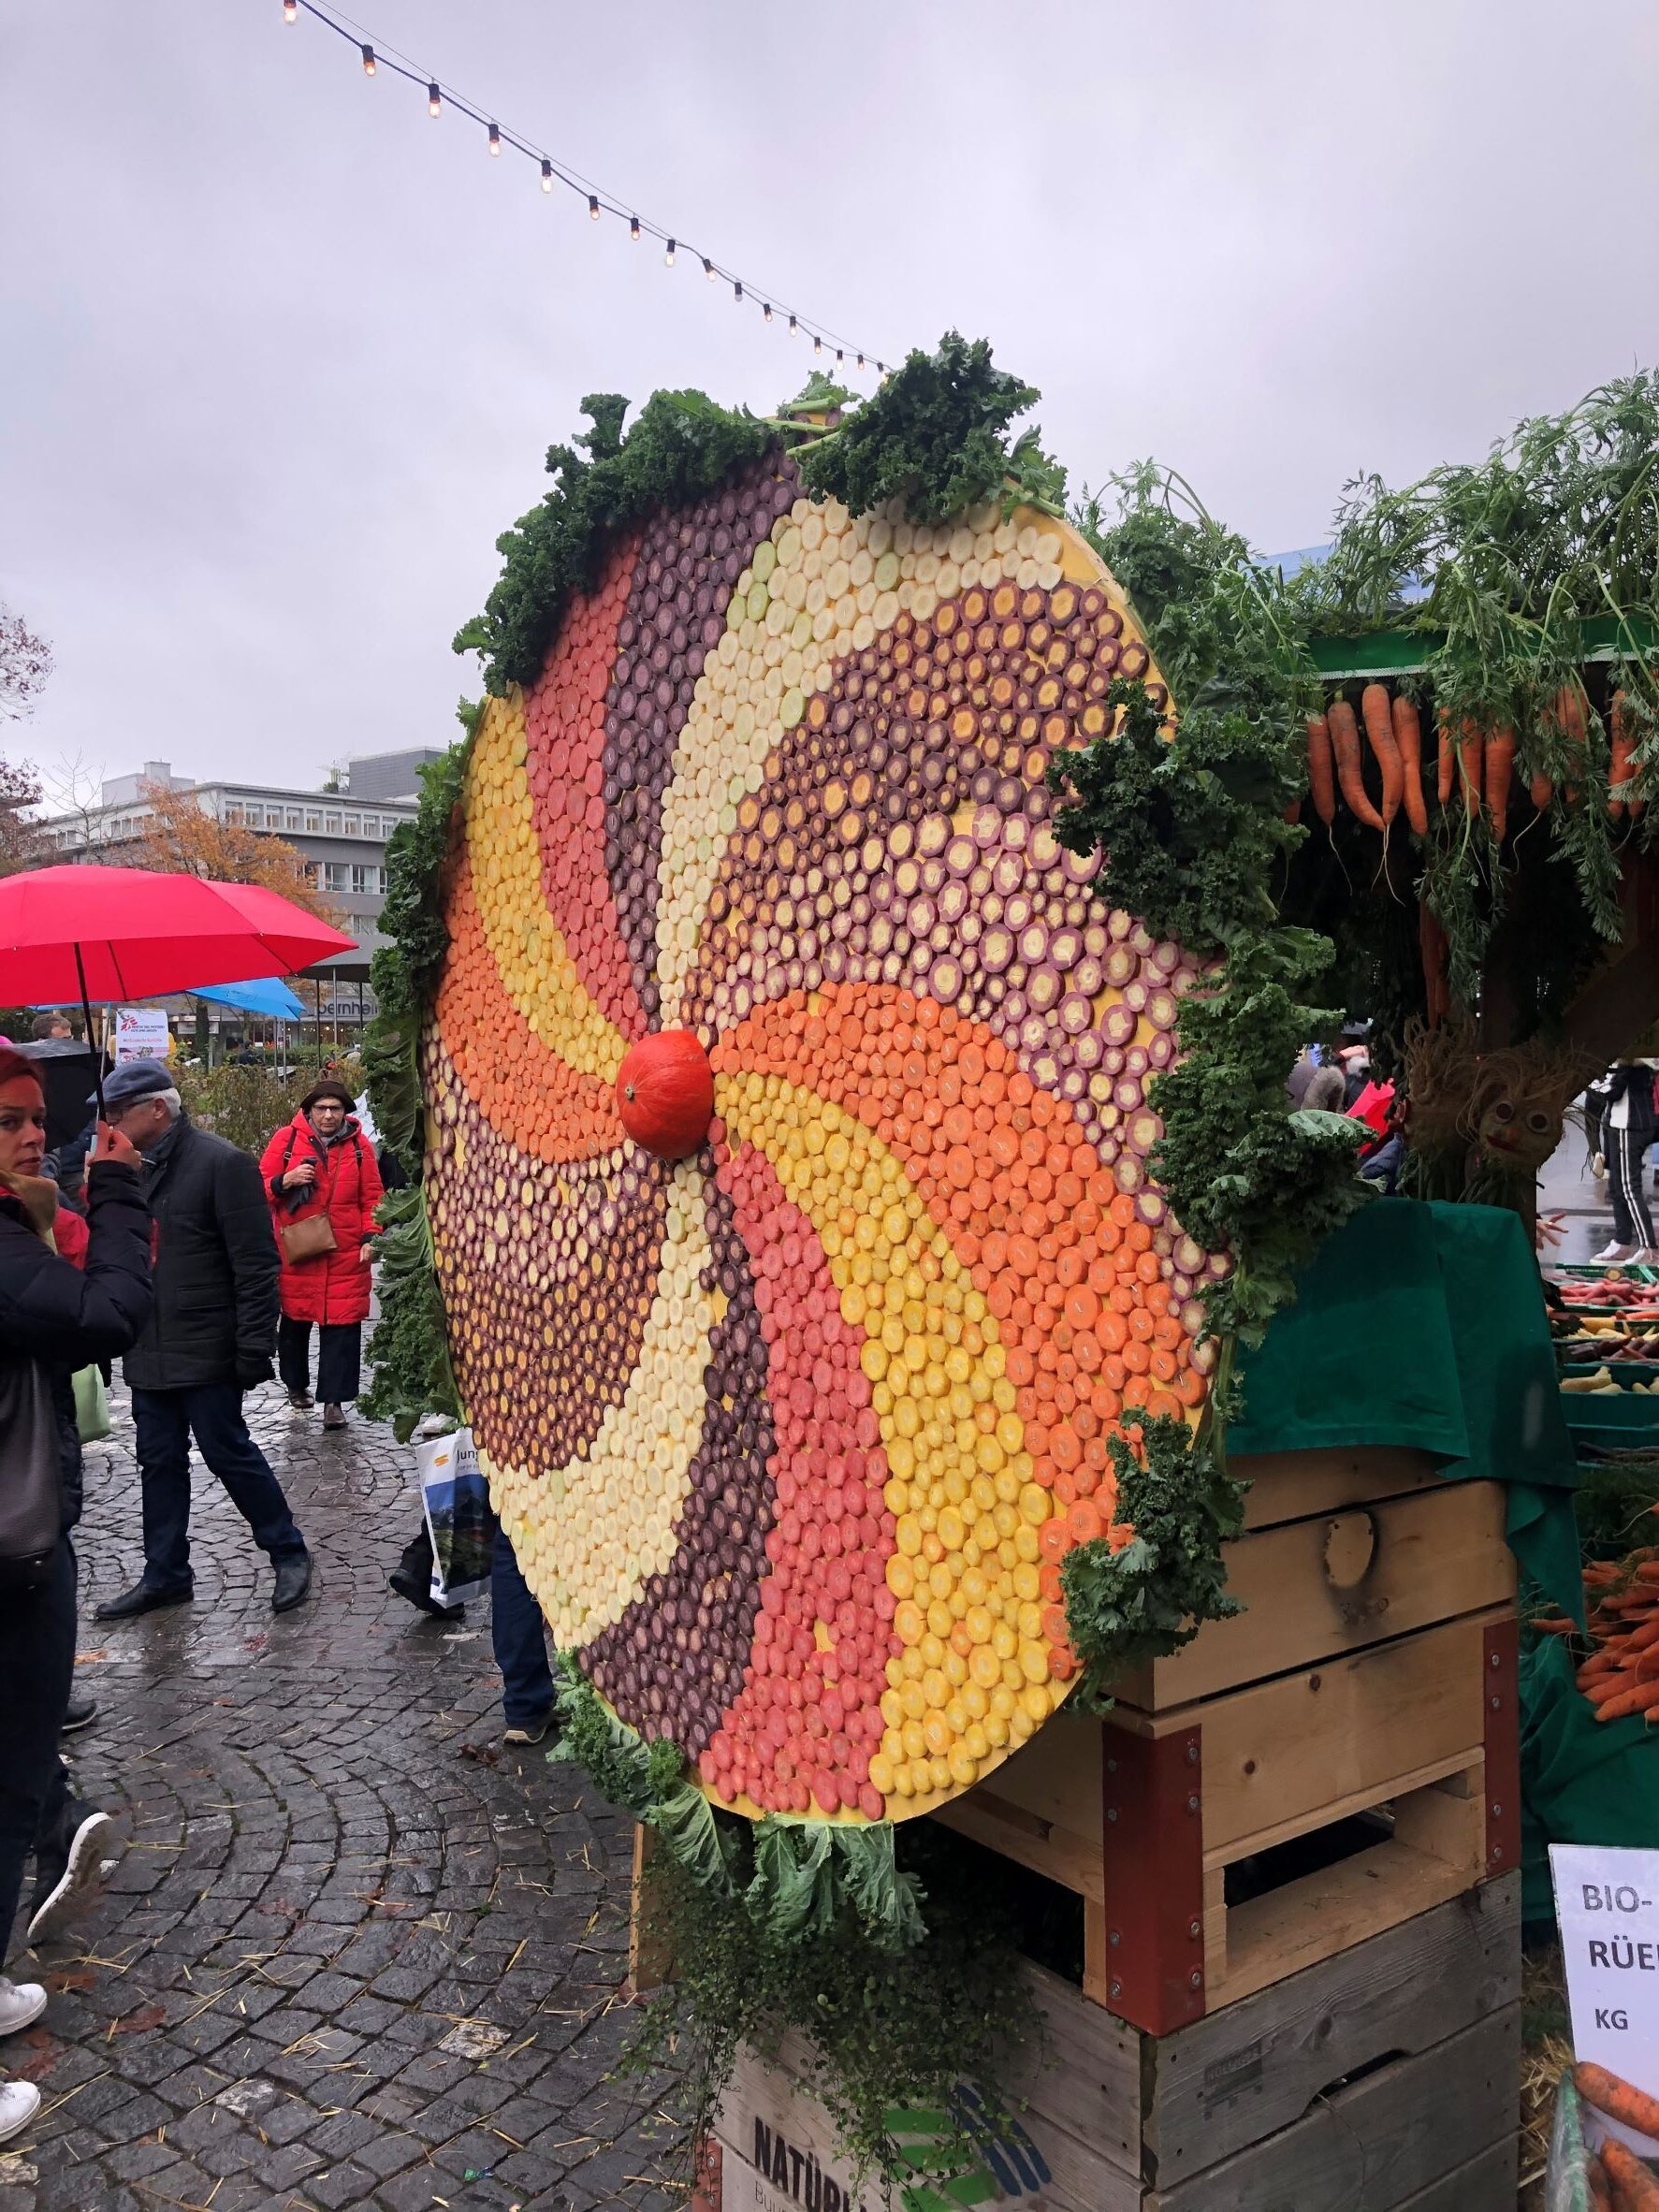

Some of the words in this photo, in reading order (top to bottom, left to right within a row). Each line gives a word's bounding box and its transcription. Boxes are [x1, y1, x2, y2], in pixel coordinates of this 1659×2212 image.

[317, 1001, 378, 1015] ernhei
[1582, 1884, 1652, 1914] BIO-
[1589, 1934, 1659, 1971] RÜE
[1595, 2008, 1629, 2030] KG
[754, 2116, 867, 2212] NATÜR
